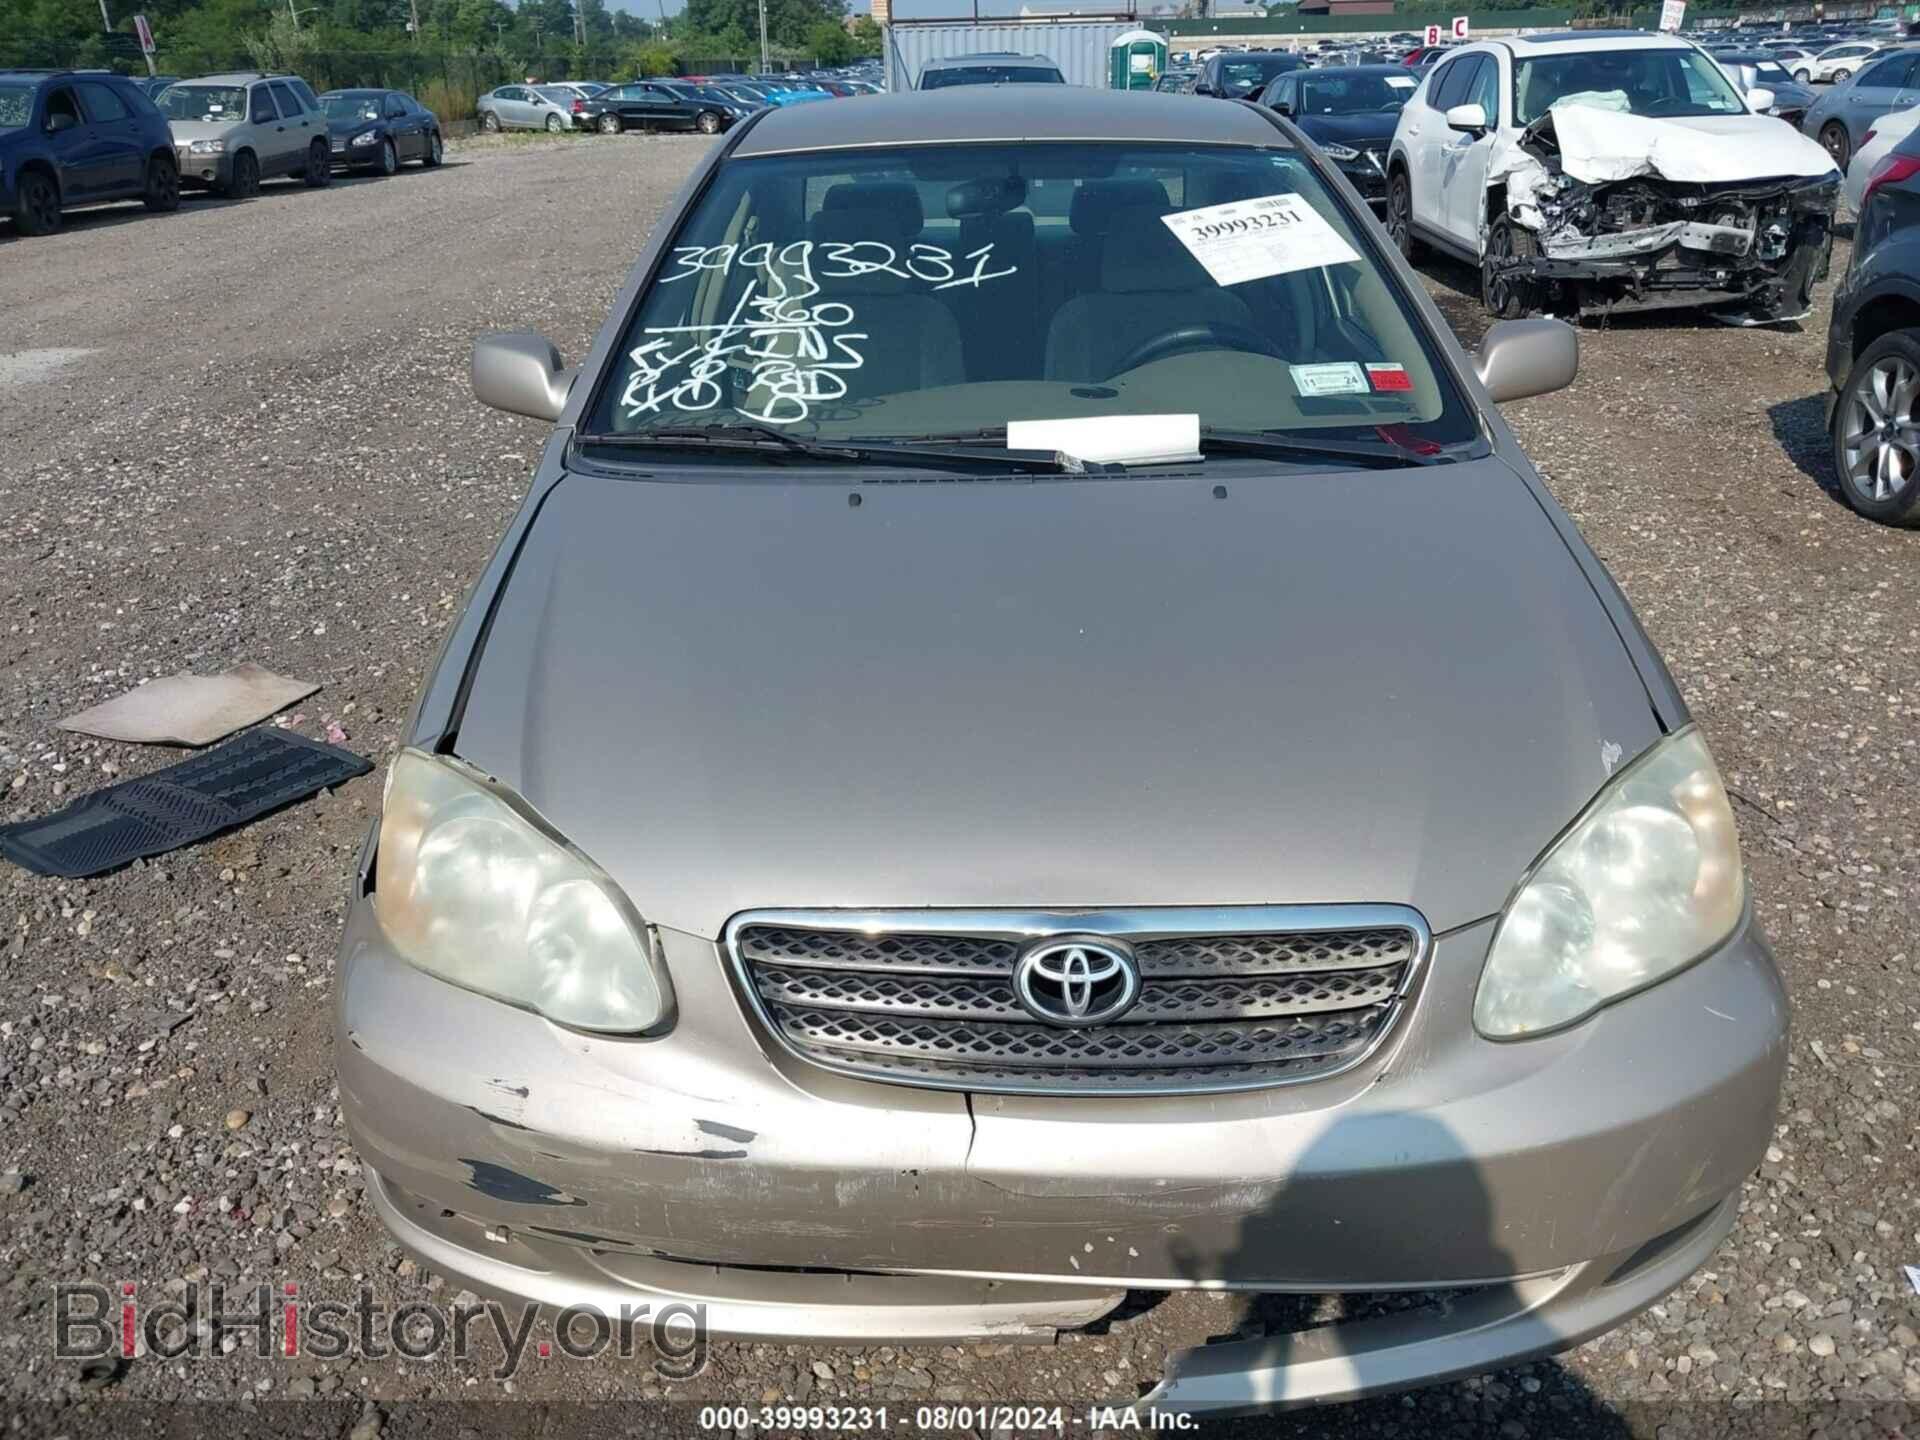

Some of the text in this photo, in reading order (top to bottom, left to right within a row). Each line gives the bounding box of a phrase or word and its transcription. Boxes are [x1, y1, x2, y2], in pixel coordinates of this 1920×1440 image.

[1428, 27, 1438, 45] B
[1455, 19, 1465, 36] C
[1191, 209, 1303, 241] 39993231
[659, 240, 1018, 300] 39993231
